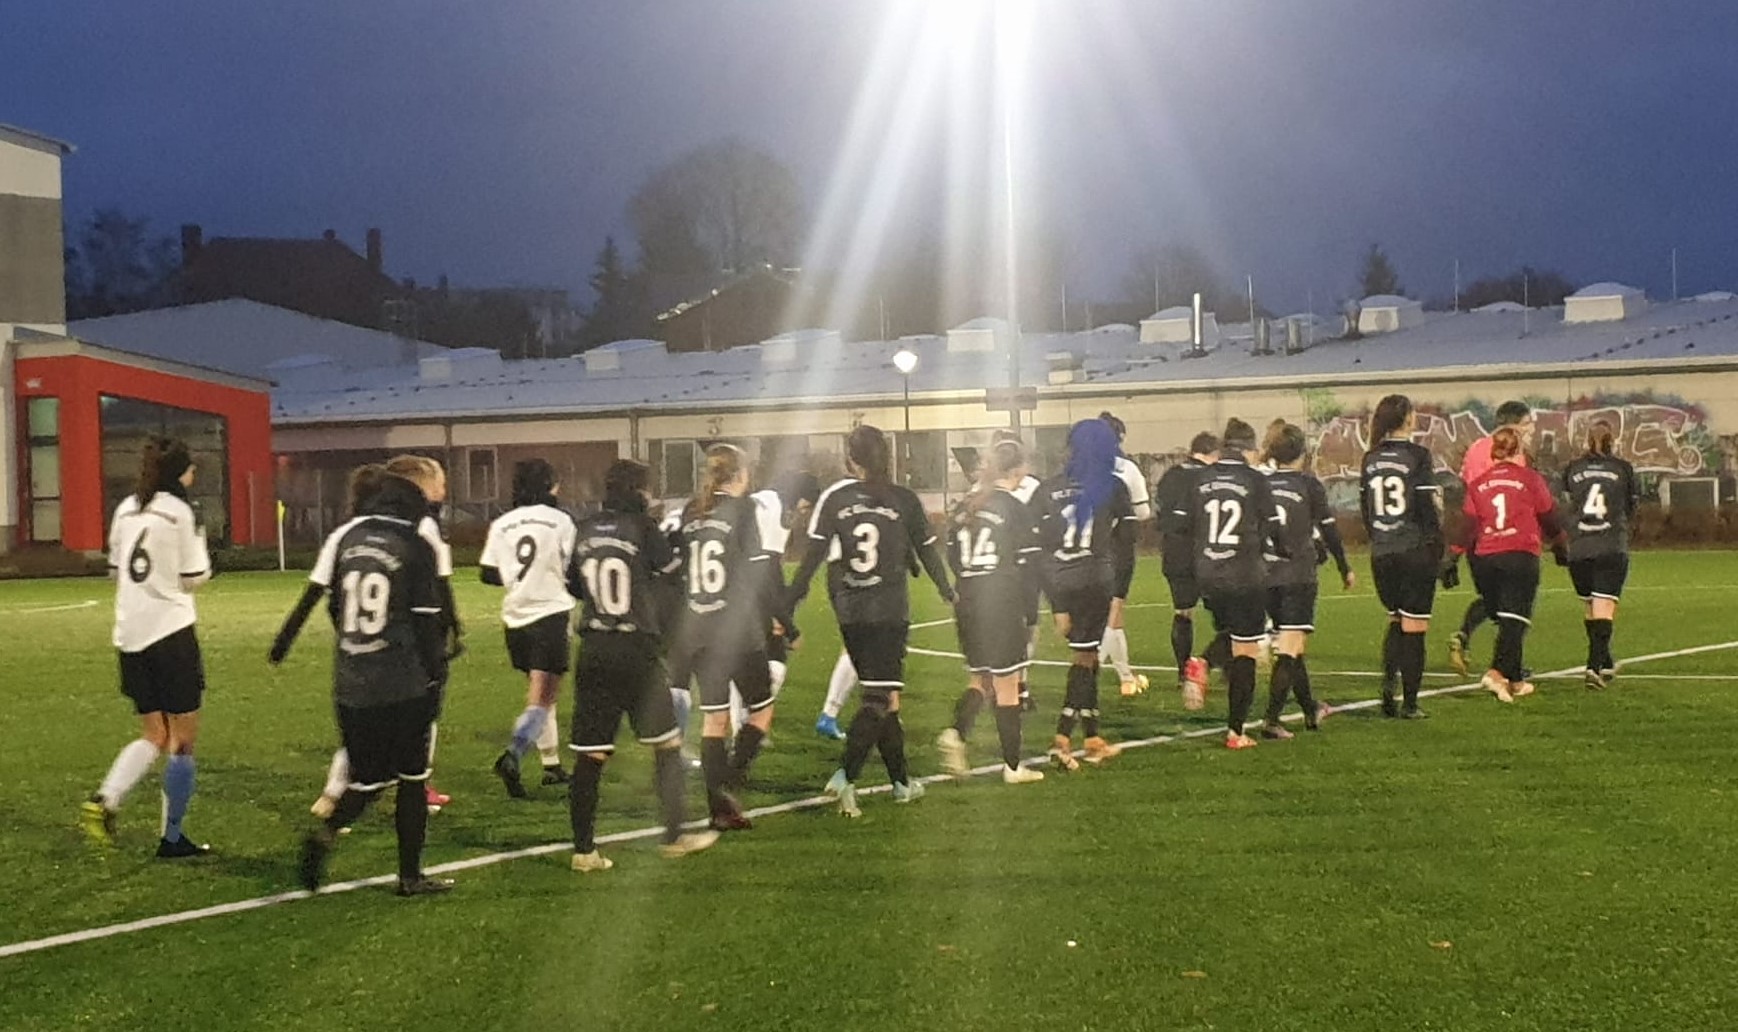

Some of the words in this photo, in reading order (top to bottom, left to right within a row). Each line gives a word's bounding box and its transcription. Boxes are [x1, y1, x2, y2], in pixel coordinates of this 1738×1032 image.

[1368, 475, 1407, 517] 13
[1491, 493, 1506, 529] 1
[1583, 483, 1608, 519] 4
[1204, 499, 1242, 544] 12
[129, 526, 152, 583] 6
[516, 535, 537, 582] 9
[689, 539, 728, 594] 16
[850, 522, 880, 573] 3
[957, 525, 1000, 569] 14
[341, 570, 391, 635] 19
[580, 556, 632, 615] 10
